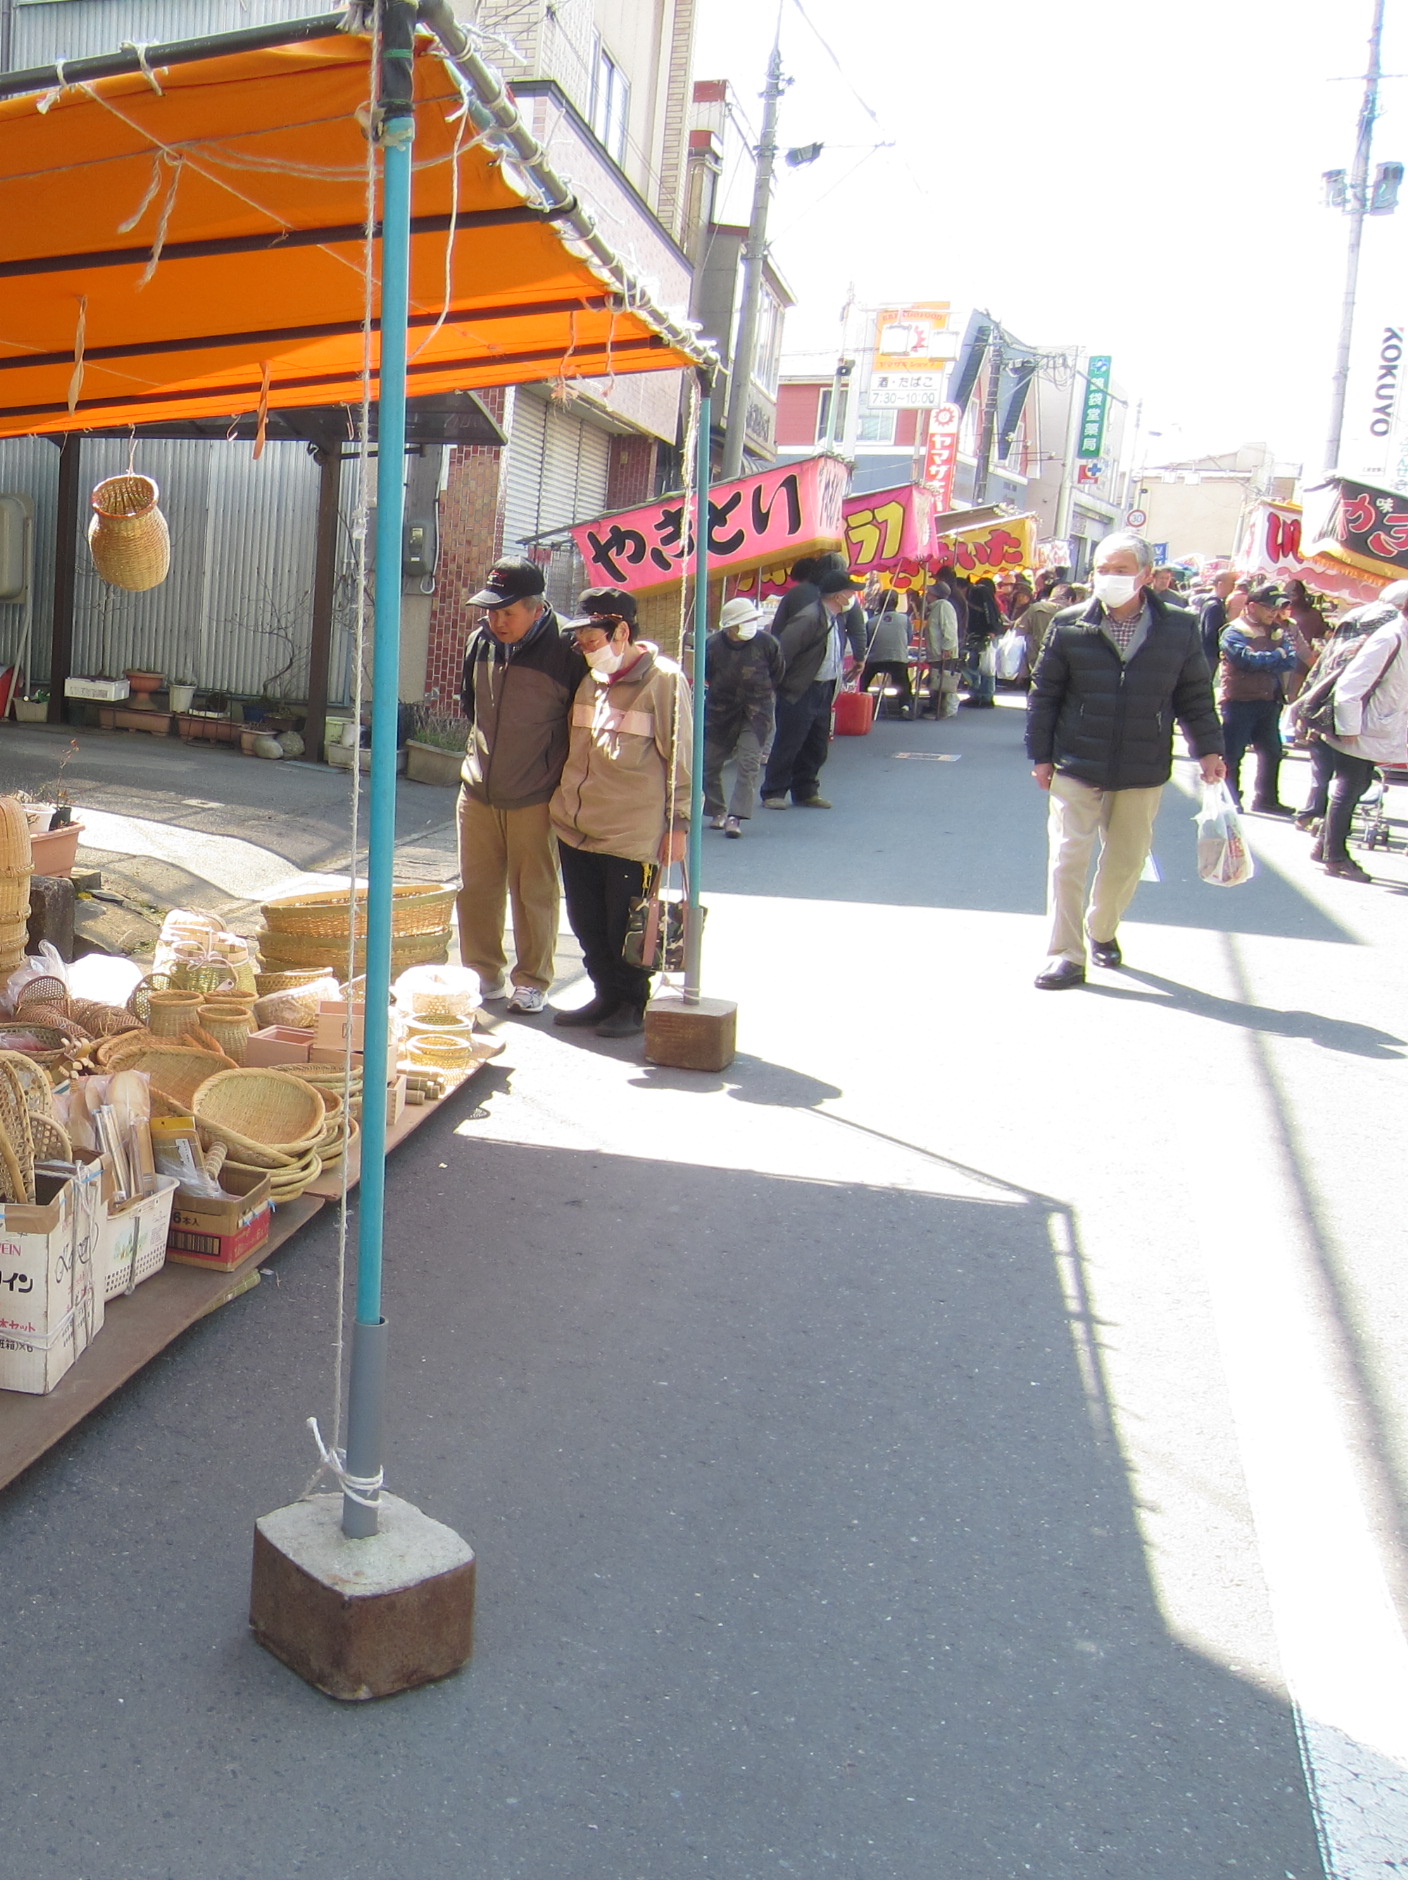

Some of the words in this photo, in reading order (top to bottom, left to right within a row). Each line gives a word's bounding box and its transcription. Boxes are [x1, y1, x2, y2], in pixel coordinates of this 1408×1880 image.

[877, 376, 933, 388] 酒・たばこ
[1369, 326, 1404, 438] KOKUYO
[586, 473, 802, 584] やきとり
[1131, 514, 1142, 524] 30
